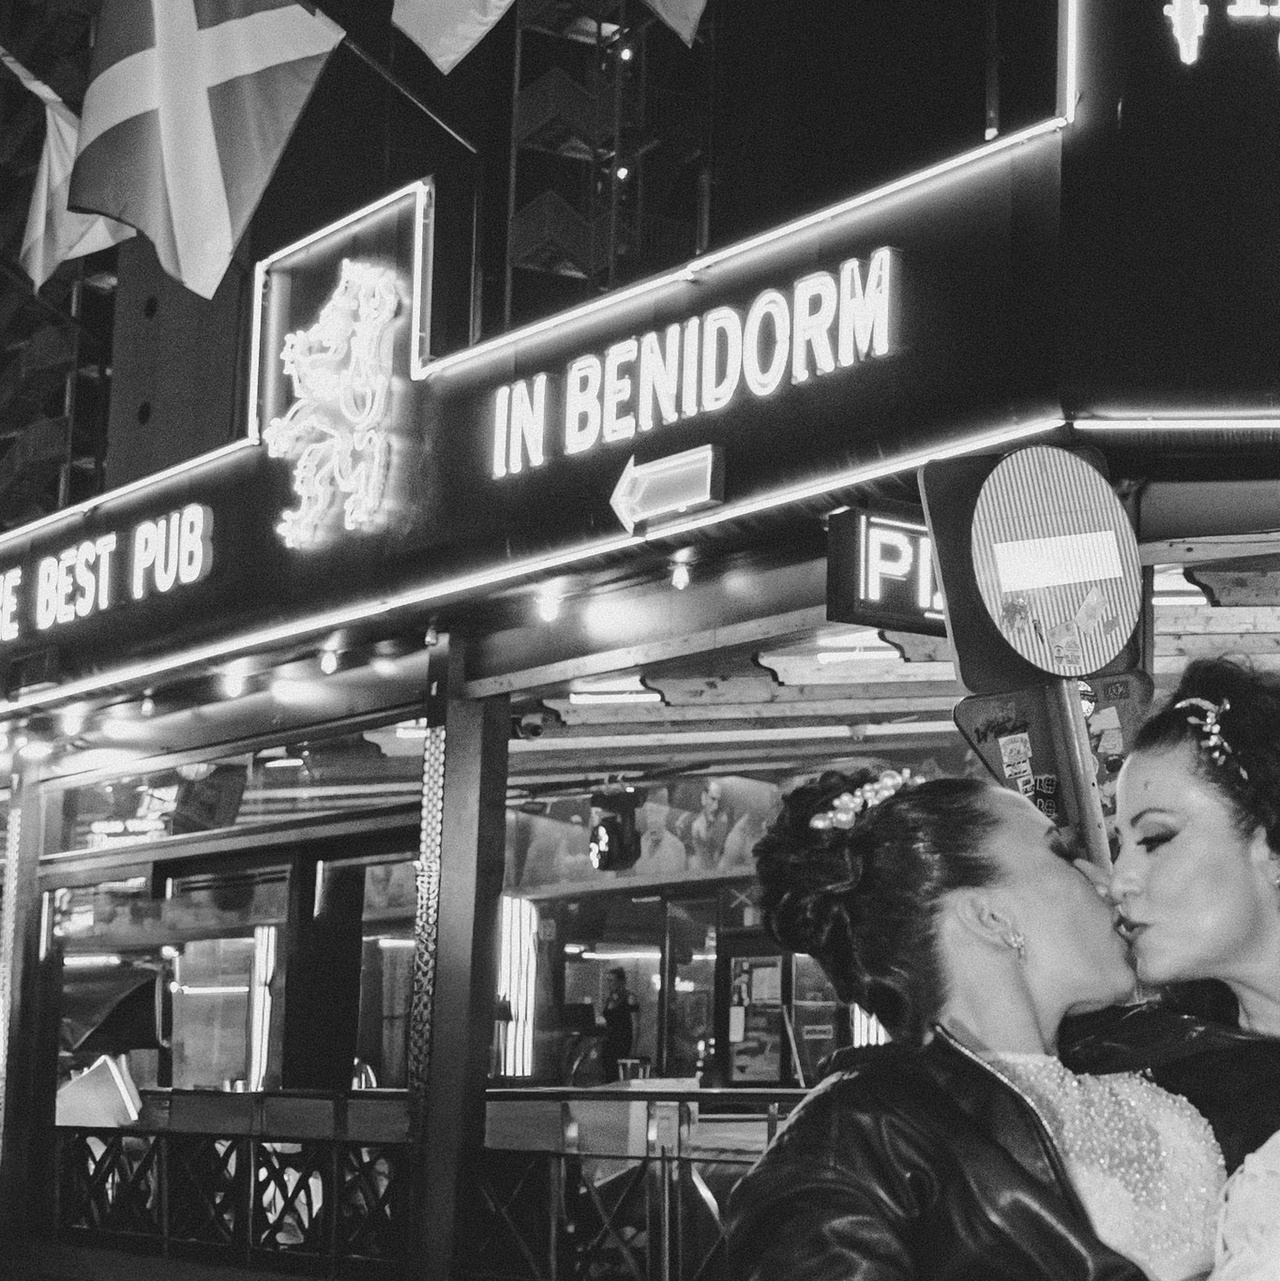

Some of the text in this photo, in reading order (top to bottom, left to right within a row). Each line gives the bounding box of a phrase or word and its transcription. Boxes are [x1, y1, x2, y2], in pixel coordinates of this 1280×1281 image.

[493, 246, 891, 480] IN BENIDORM
[37, 532, 116, 630] BEST
[133, 503, 208, 599] PUB
